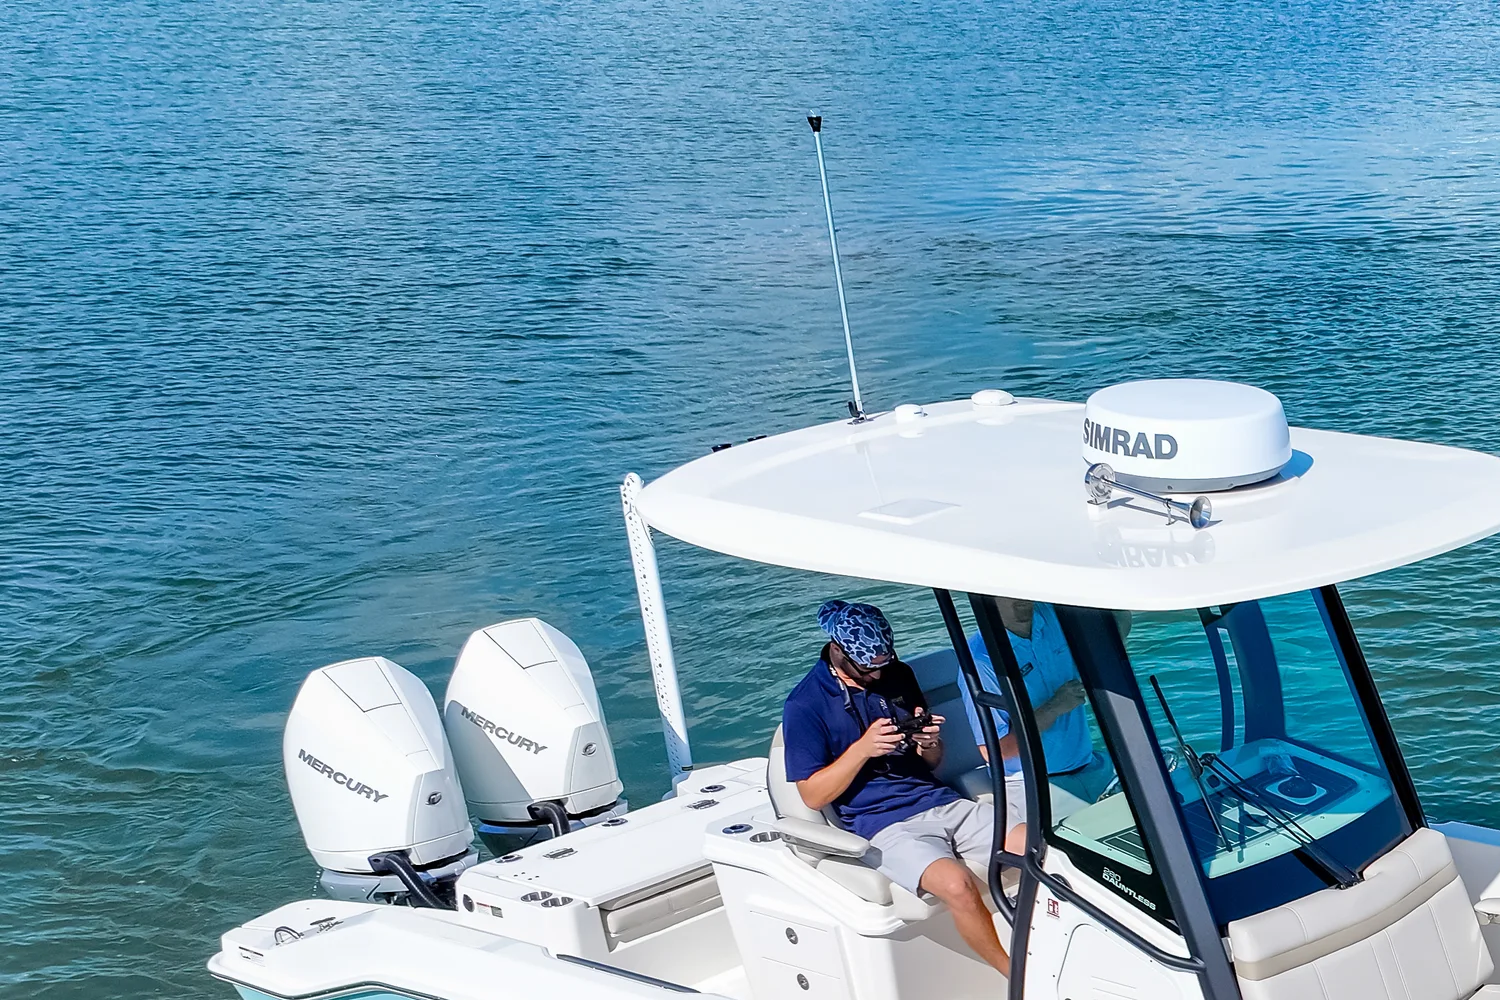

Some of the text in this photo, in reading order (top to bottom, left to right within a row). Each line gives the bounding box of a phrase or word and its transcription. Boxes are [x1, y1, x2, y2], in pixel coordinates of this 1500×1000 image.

[1083, 418, 1178, 460] SIMRAD
[461, 706, 548, 755] MERCURY
[298, 749, 389, 803] MERCURY
[1102, 873, 1156, 911] DAUNTLESS
